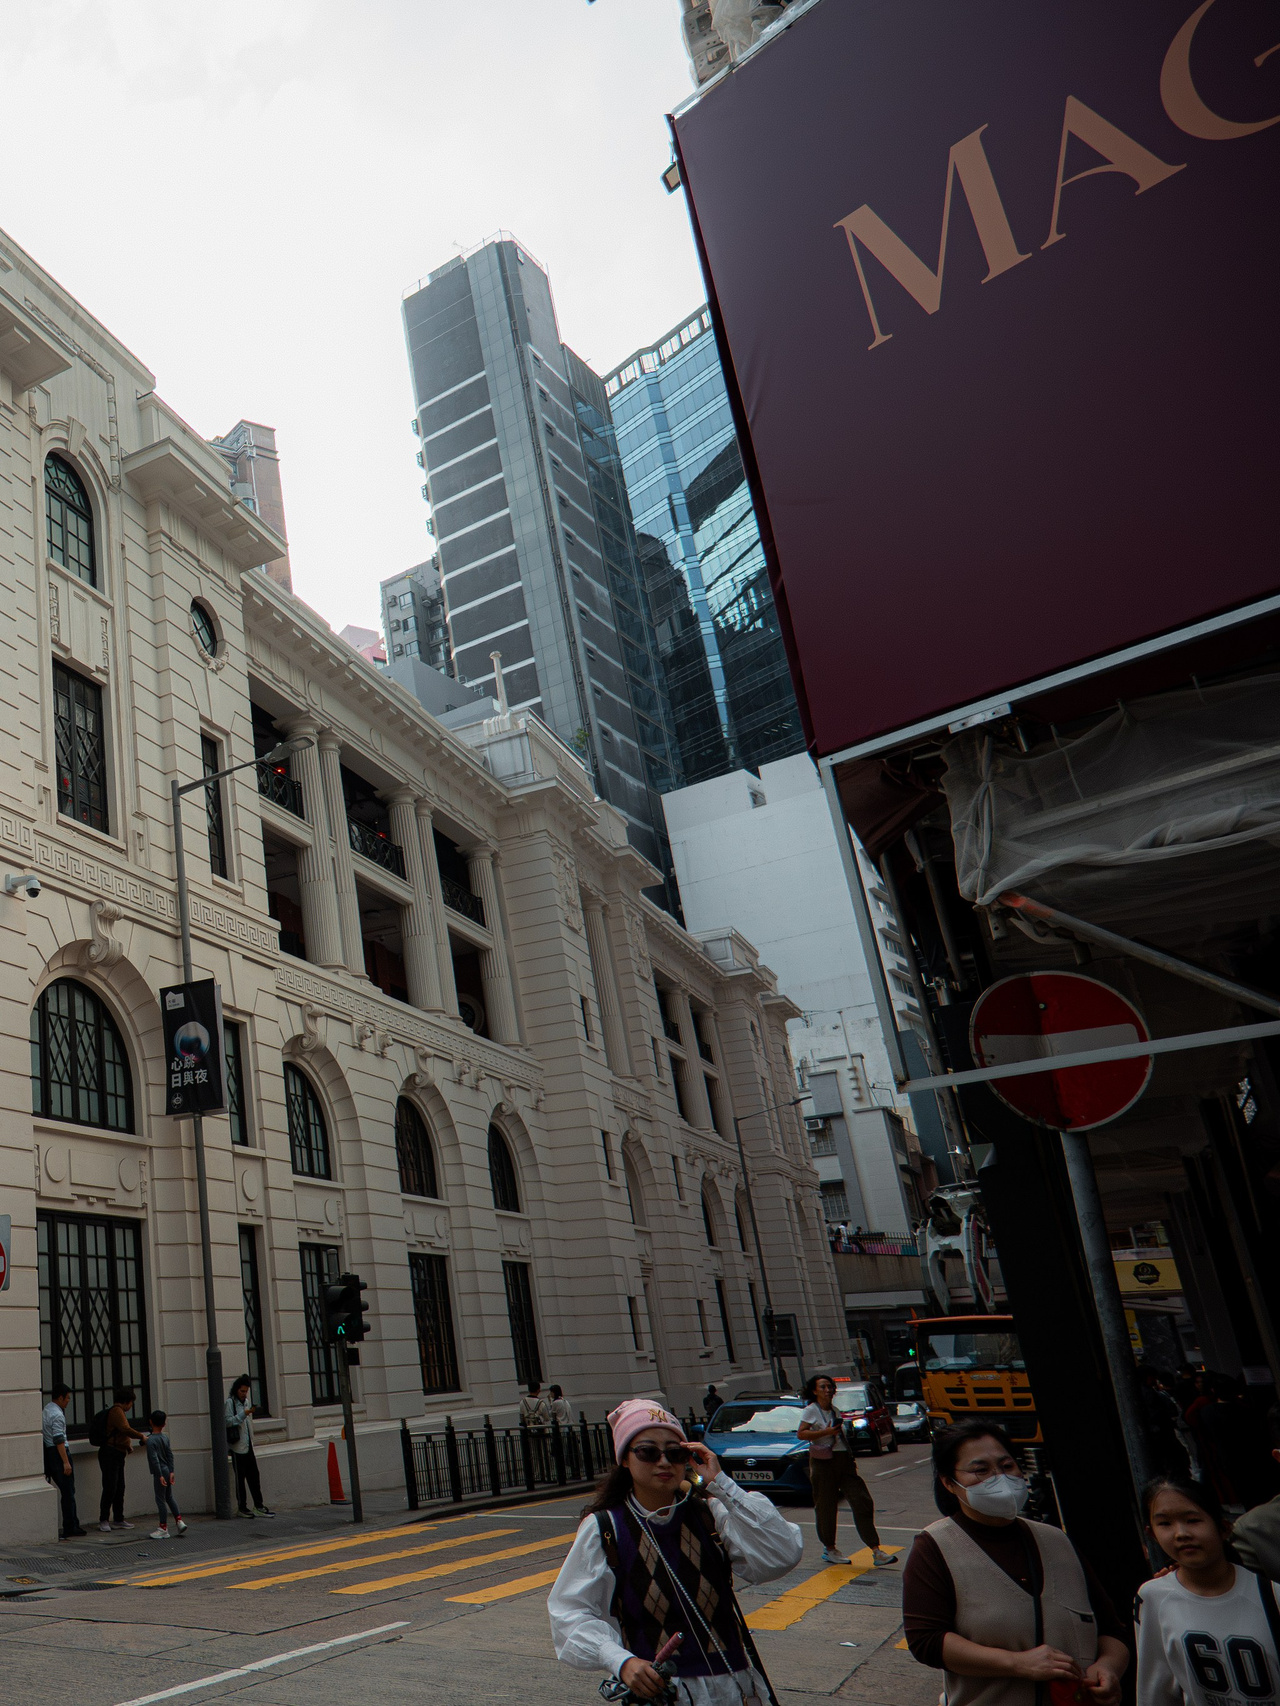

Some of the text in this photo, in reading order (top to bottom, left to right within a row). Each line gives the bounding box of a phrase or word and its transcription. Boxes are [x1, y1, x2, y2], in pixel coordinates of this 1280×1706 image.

[171, 1053, 196, 1071] 心跳
[171, 1068, 208, 1089] 日與夜
[1181, 1630, 1275, 1700] 60
